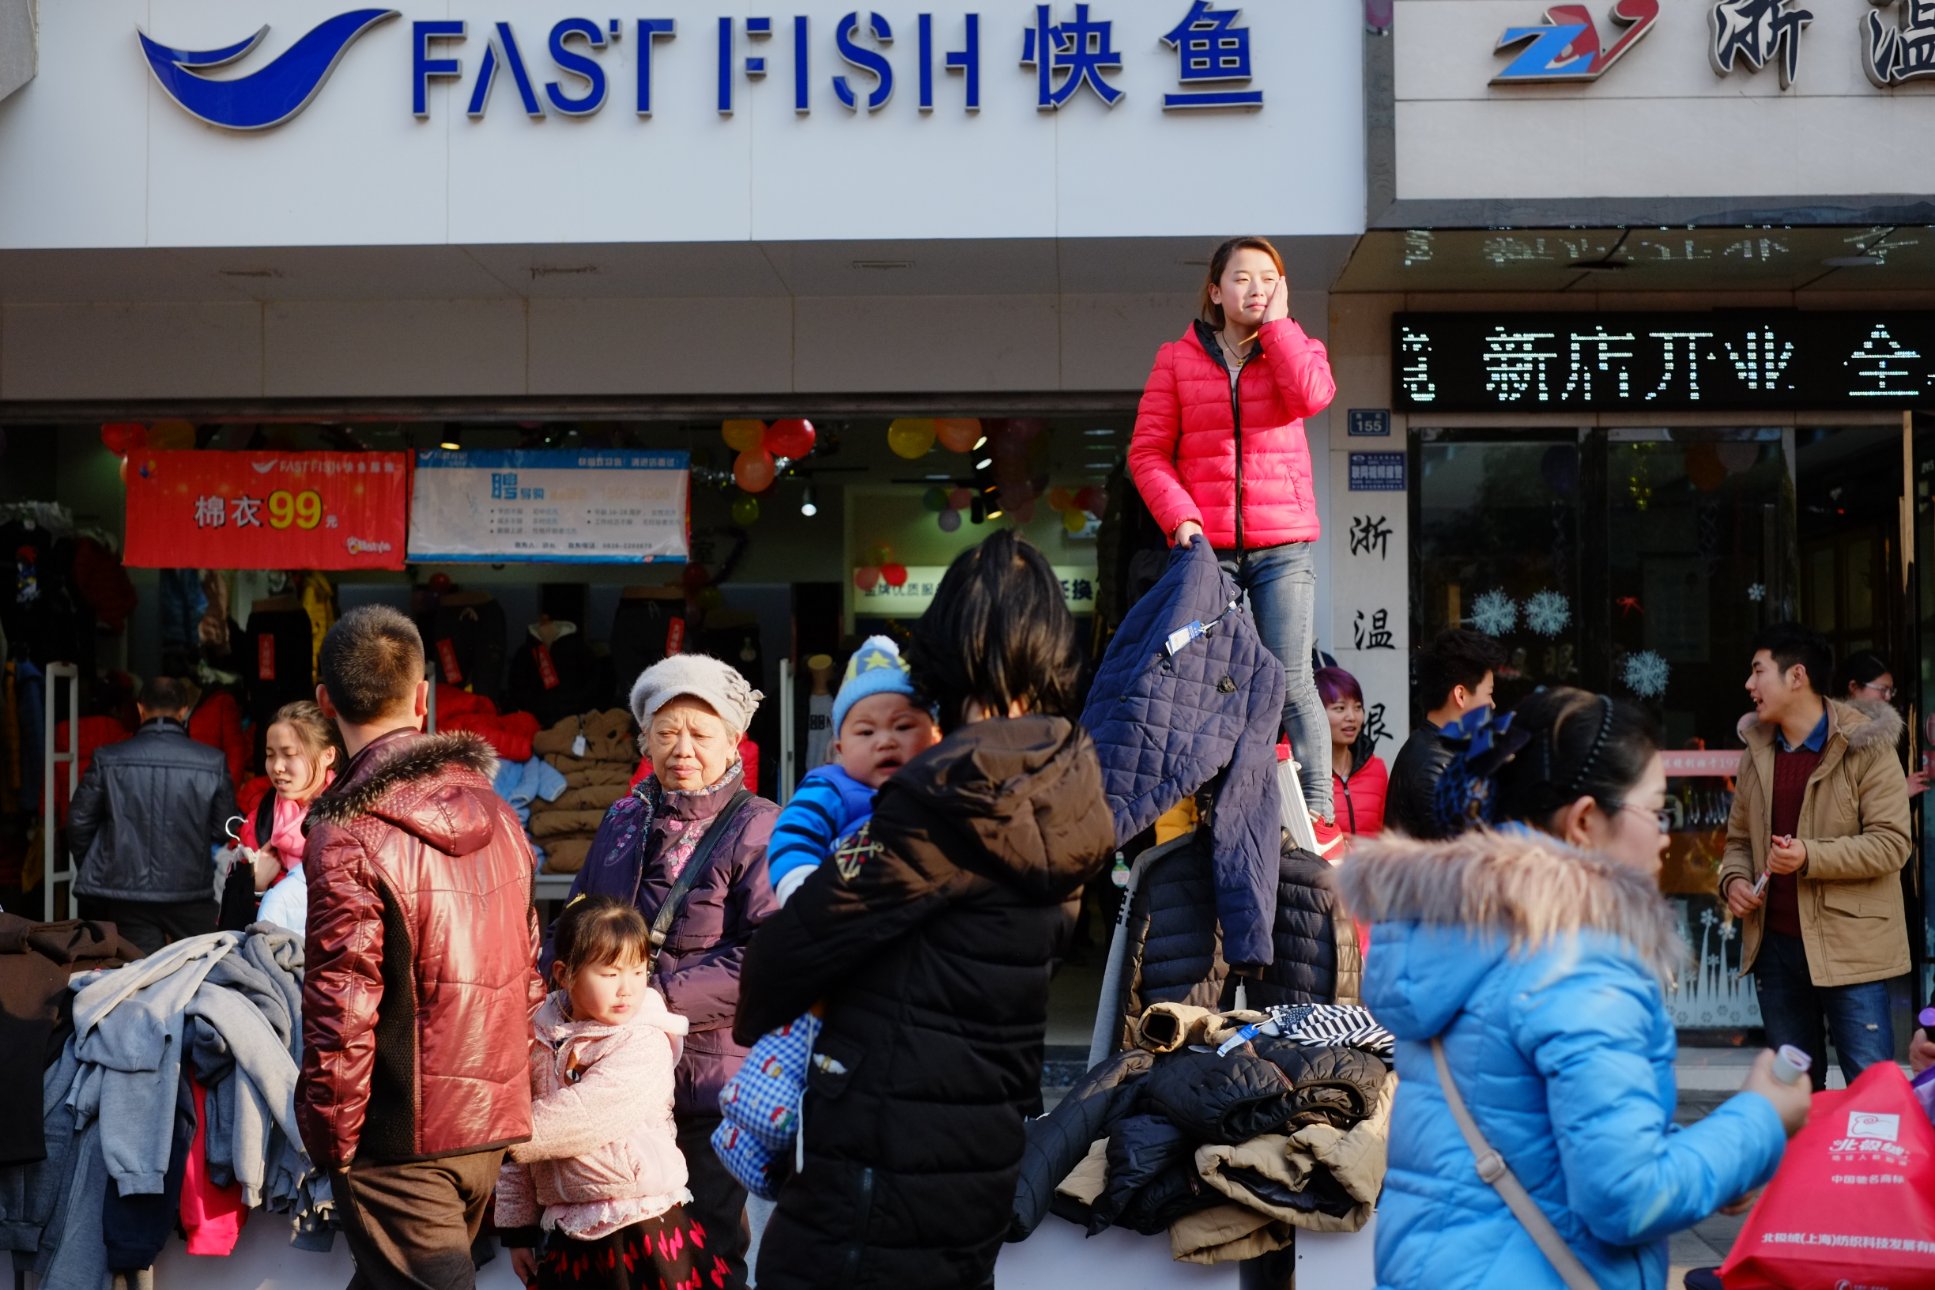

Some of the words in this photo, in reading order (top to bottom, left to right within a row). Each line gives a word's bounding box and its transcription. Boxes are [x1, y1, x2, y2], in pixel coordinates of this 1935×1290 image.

[412, 17, 677, 120] FAST
[716, 10, 982, 116] FISH
[1019, 0, 1264, 112] 快鱼
[1843, 324, 1935, 397] 全
[1356, 420, 1382, 432] 155
[194, 495, 264, 528] 棉衣
[268, 489, 323, 530] 99
